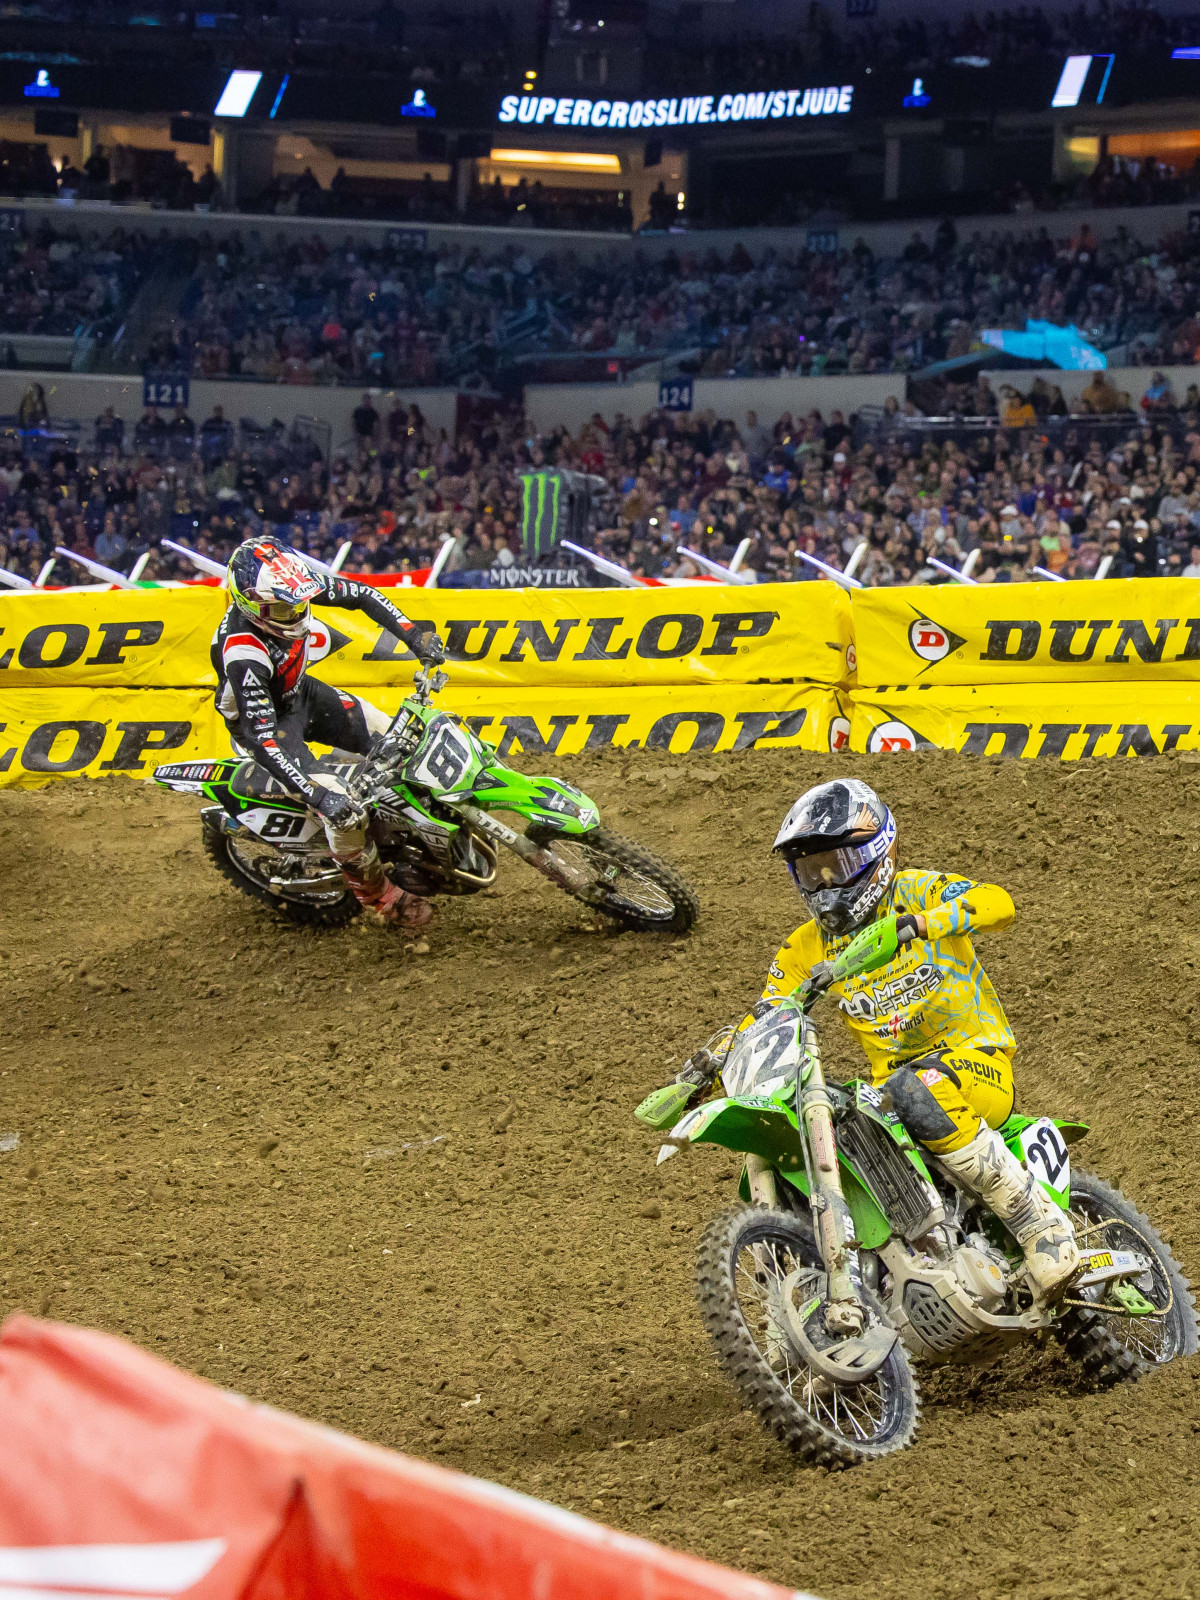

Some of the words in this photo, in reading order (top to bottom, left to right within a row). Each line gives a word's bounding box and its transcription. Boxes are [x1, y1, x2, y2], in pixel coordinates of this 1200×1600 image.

[148, 384, 184, 403] 121
[662, 386, 690, 406] 124
[491, 566, 580, 587] MONSTER
[0, 620, 165, 669] OP
[0, 720, 193, 773] OP
[427, 728, 469, 791] 81
[260, 812, 307, 838] 81
[872, 963, 934, 1002] MADD
[878, 970, 943, 1017] PARTS
[949, 1058, 1002, 1084] CIRCUIT
[1027, 1125, 1068, 1185] 22
